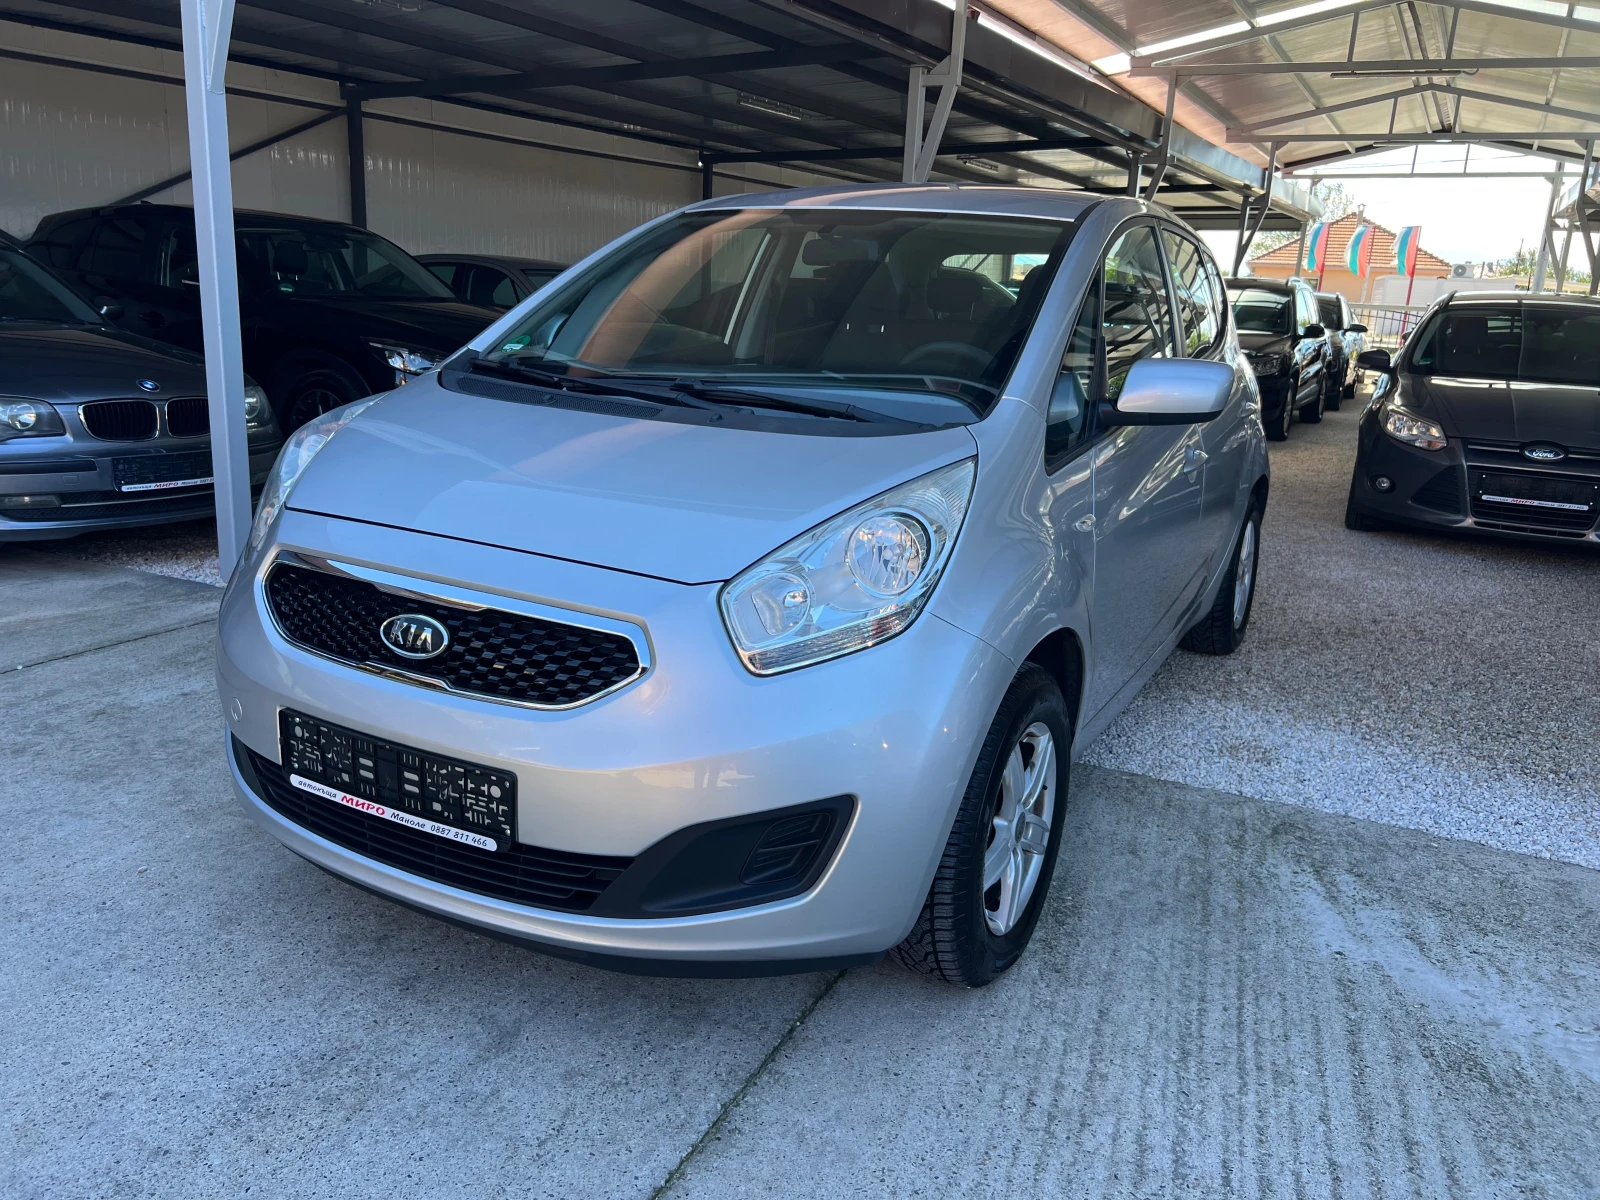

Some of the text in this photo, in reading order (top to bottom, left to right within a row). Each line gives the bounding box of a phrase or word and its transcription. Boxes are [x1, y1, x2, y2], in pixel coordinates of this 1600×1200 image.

[1532, 449, 1556, 458] Ford
[154, 481, 178, 489] МИРО
[388, 619, 432, 652] KIA
[298, 780, 487, 847] автокъща МИРО Маноле 0887 811 466
